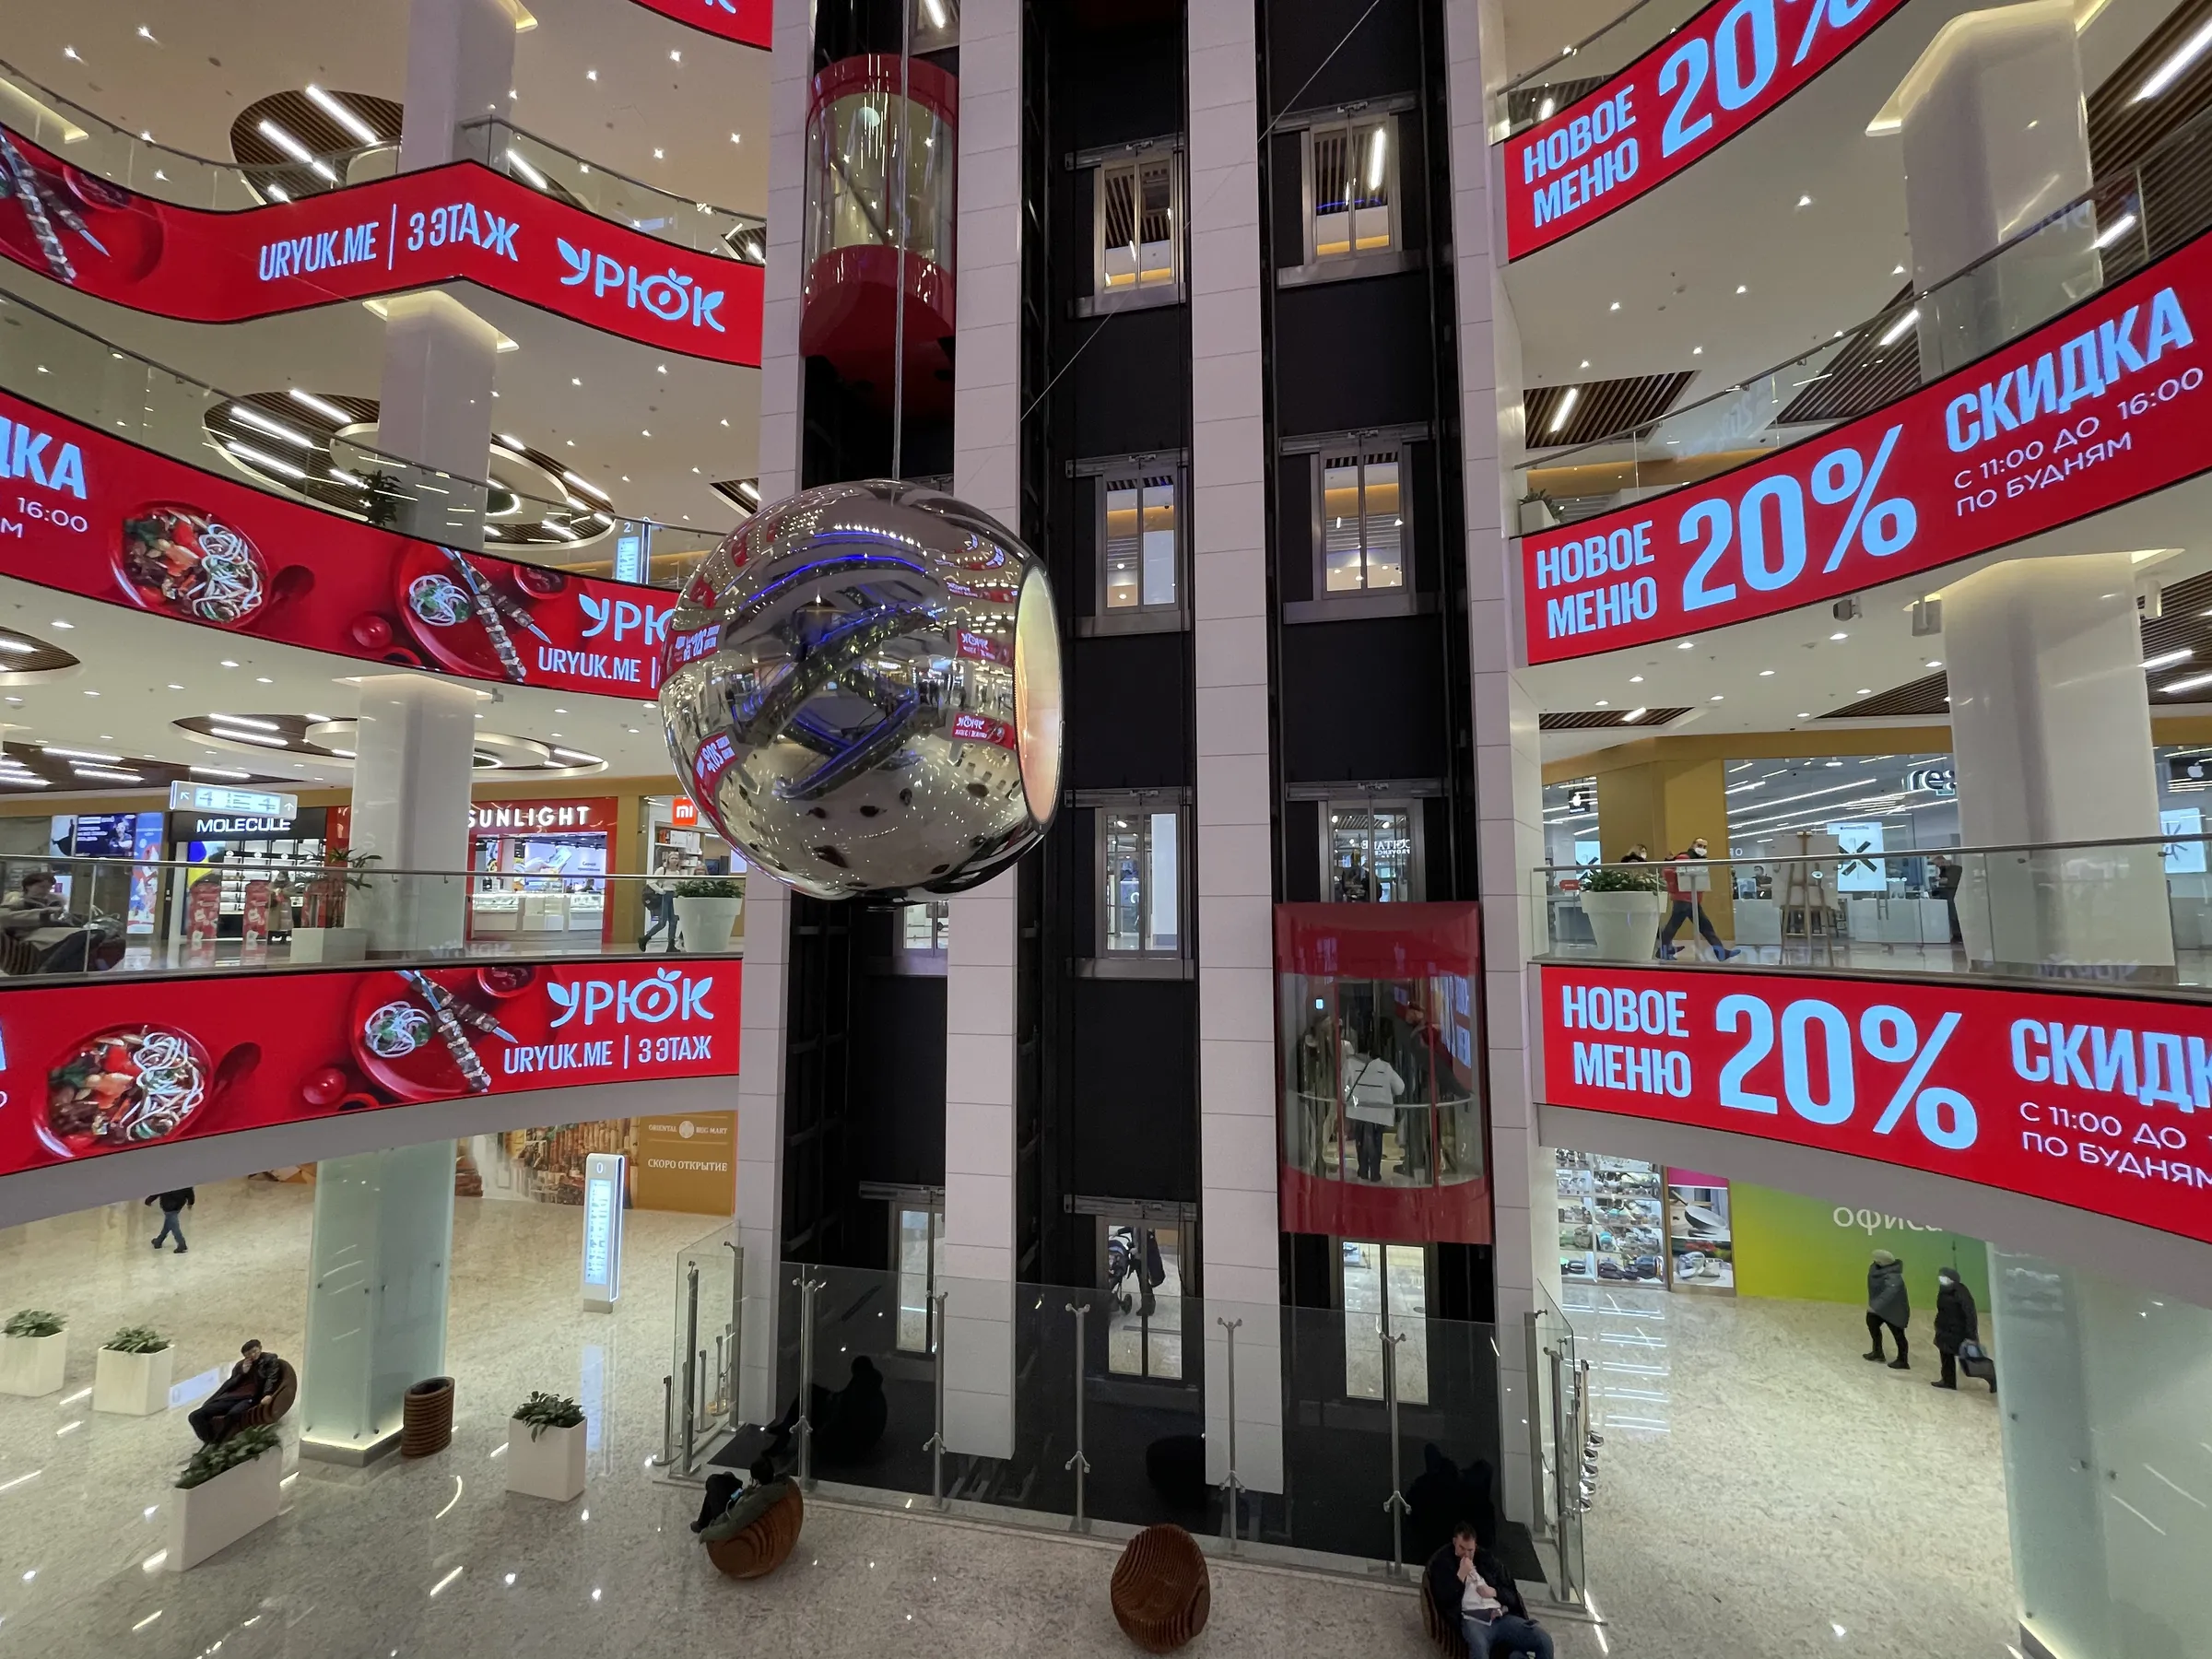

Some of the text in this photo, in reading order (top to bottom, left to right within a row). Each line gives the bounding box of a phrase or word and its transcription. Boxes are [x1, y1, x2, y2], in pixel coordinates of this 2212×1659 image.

[1523, 84, 1637, 185] НОВОЕ
[1533, 137, 1640, 229] МЕНЮ
[259, 222, 380, 281] URYUK.ME
[407, 202, 520, 262] 3 ЭТАЖ
[556, 238, 727, 333] УРЮК
[1945, 287, 2194, 453] СКИДКА
[1979, 441, 2044, 479] 11:00
[2053, 417, 2100, 454] ДО
[2117, 367, 2204, 420] 16:00
[1957, 431, 2132, 517] ПО БУДНЯМ
[17, 497, 88, 533] 16:00
[1678, 423, 1918, 612] 20%
[1535, 520, 1655, 590] НОВОЕ
[578, 593, 677, 646] УРЮ
[1547, 547, 1658, 640] МЕНЮ
[537, 645, 641, 683] URYUK.ME
[196, 818, 291, 833] MOLECULE
[468, 806, 591, 829] SUNLIGHT
[547, 966, 714, 1029] УРЮК
[1561, 984, 1689, 1038] НОВОЕ
[503, 1041, 614, 1075] URYUK.ME
[638, 1035, 712, 1064] 3 ЭТАЖ
[1572, 1041, 1692, 1099] МЕНЮ
[1715, 994, 1979, 1150] 20%
[2048, 1106, 2123, 1137] 11:00
[2133, 1123, 2187, 1149] ДО
[647, 1158, 728, 1172] СКОРО ОТКРЫТИЕ
[2022, 1131, 2212, 1189] ПО БУДНЯМ
